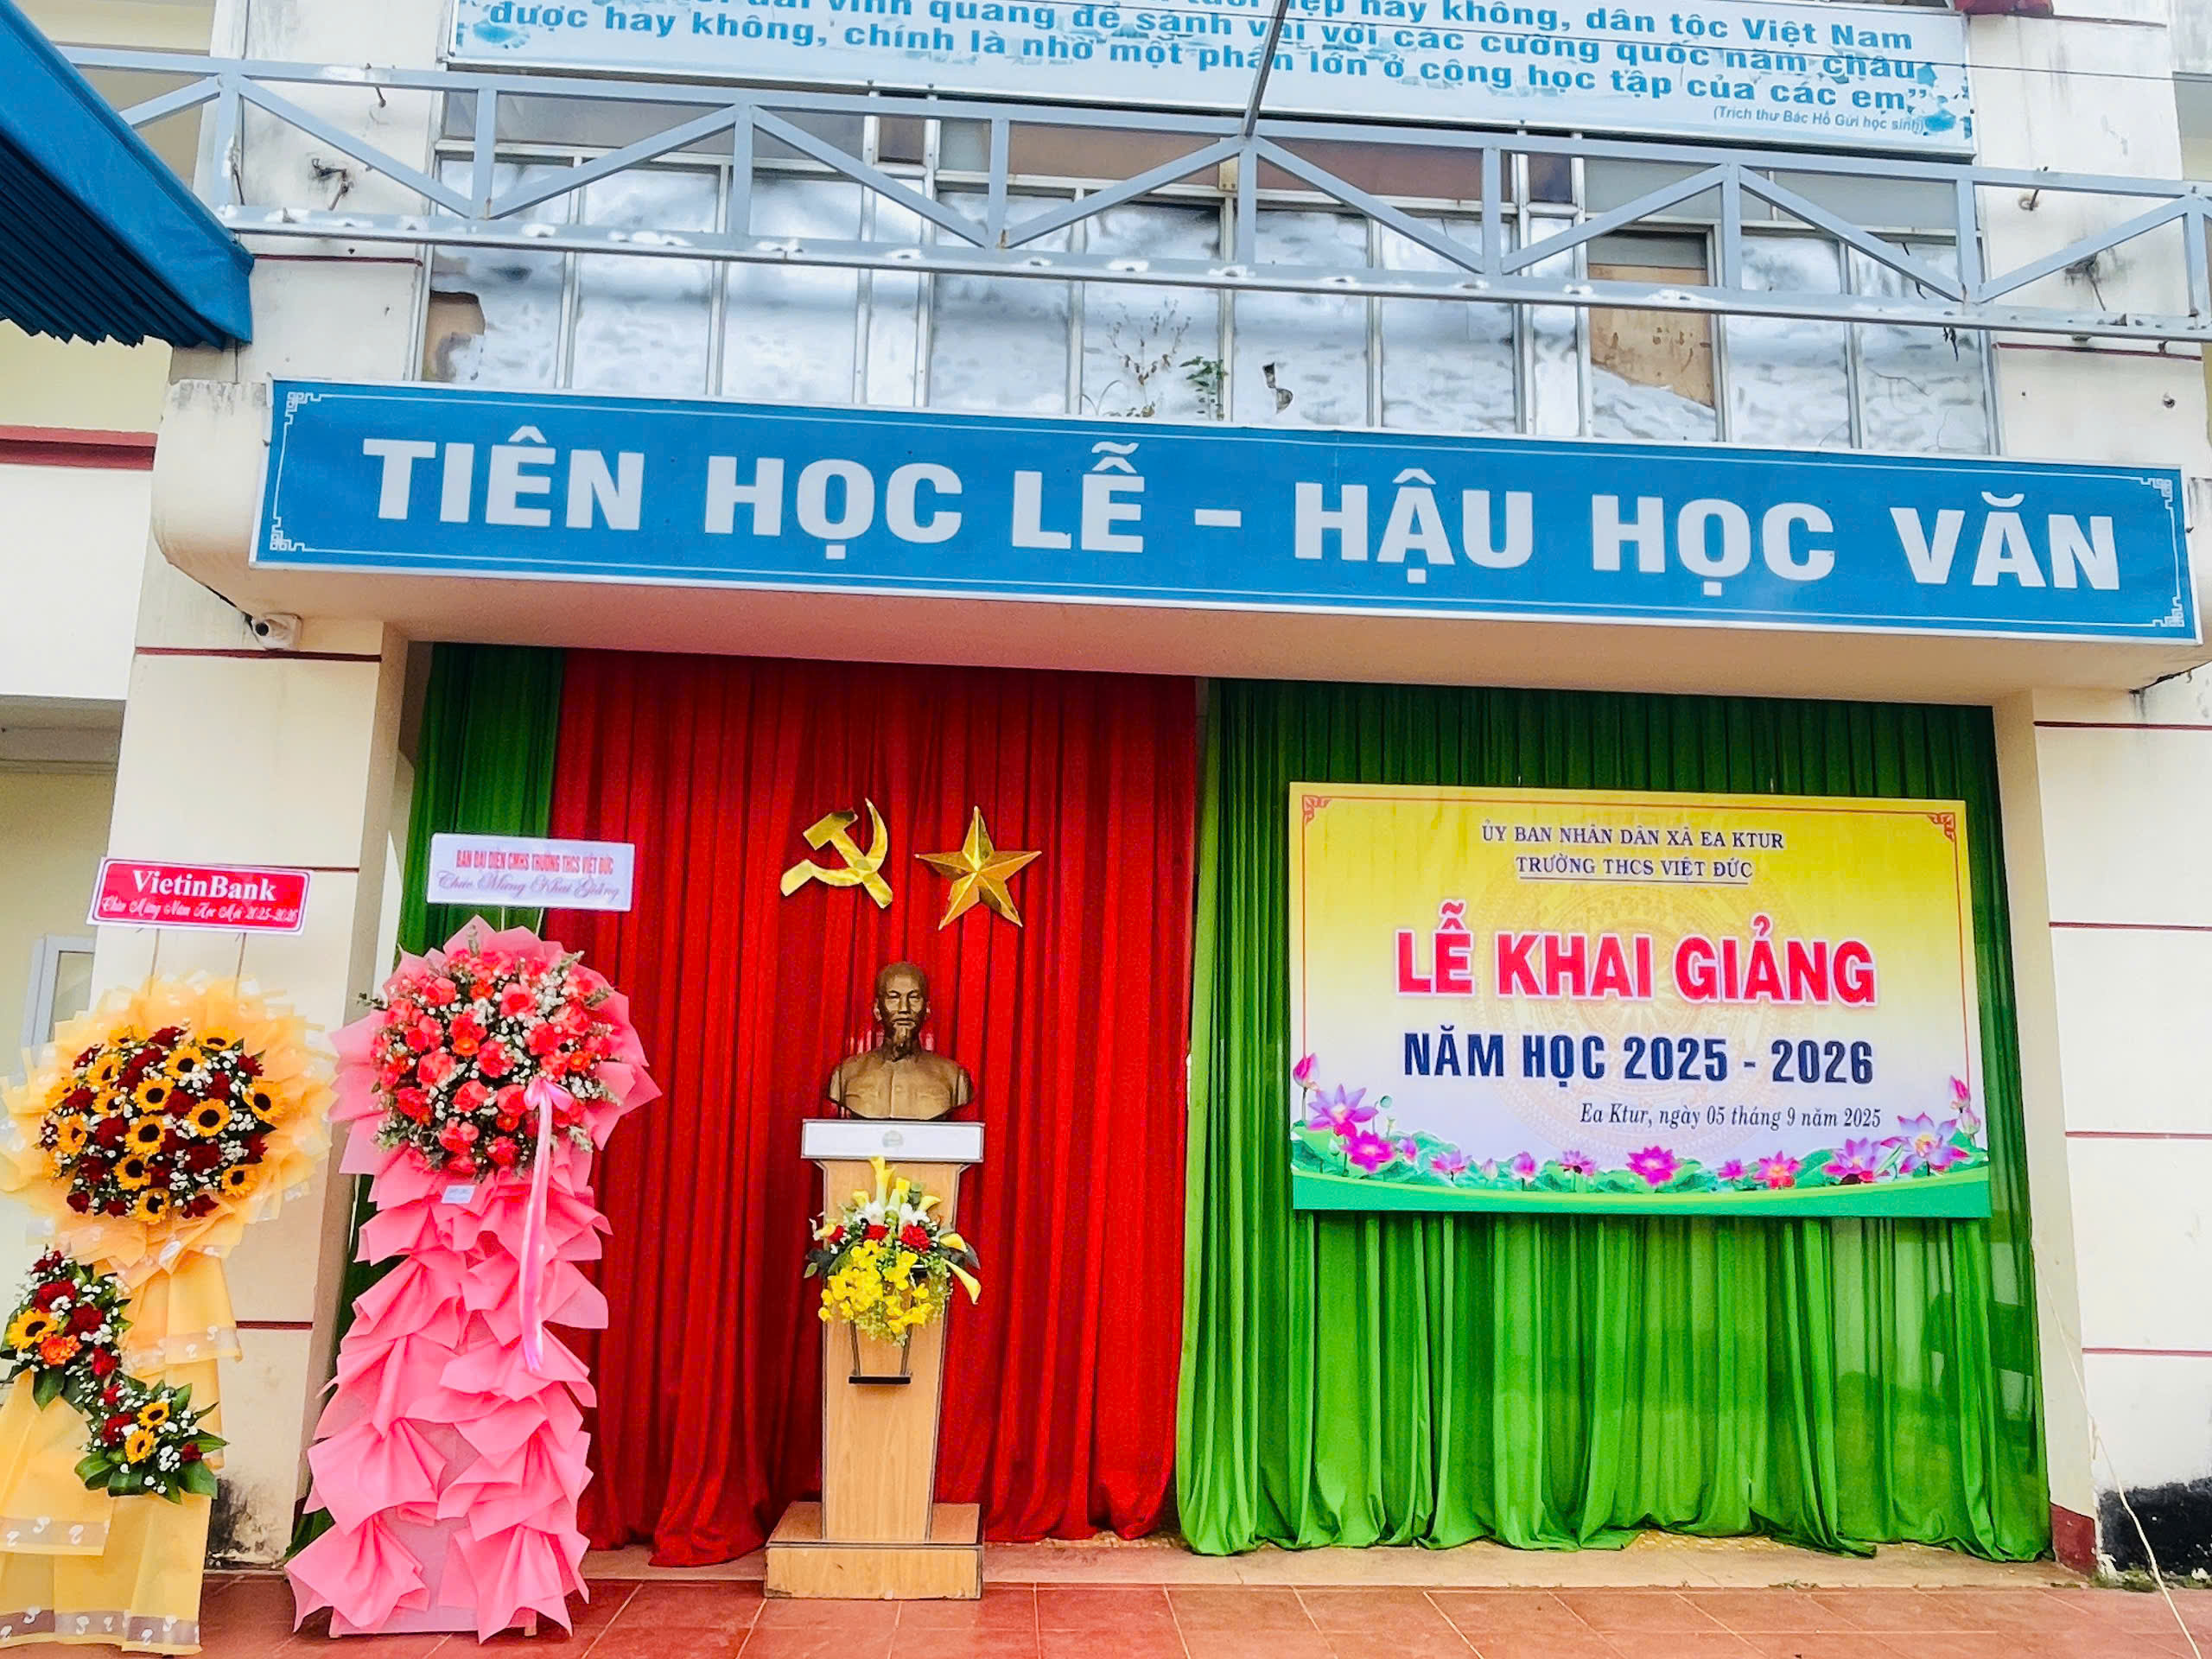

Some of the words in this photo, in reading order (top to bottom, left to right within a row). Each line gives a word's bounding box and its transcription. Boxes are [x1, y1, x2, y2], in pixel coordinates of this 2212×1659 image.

[929, 0, 1055, 29] quang
[1072, 1, 1121, 29] để
[1822, 54, 1916, 79] châu
[1361, 0, 1427, 23] hay
[1442, 0, 1570, 31] không,
[1586, 7, 1655, 33] dân
[1669, 13, 1728, 40] tộc
[1742, 17, 1817, 48] Việt
[1831, 24, 1913, 49] Nam
[489, 2, 588, 32] được
[605, 6, 676, 38] hay
[691, 12, 827, 47] không,
[844, 23, 955, 50] chính
[970, 30, 1005, 54] là
[1023, 35, 1094, 60] nhờ
[1109, 40, 1183, 68] một
[1310, 51, 1368, 76] lớn
[1384, 54, 1405, 79] ở
[1420, 59, 1512, 88] công
[1529, 64, 1596, 93] học
[1611, 69, 1673, 99] tập
[1687, 74, 1755, 100] của
[1771, 81, 1837, 105] các
[1756, 108, 1780, 122] thư
[1863, 115, 1887, 131] học
[362, 425, 645, 531] TIÊN
[703, 454, 963, 561] HỌC
[1012, 442, 1146, 554] LỄ
[1294, 467, 1535, 585] HẬU
[1591, 493, 1836, 597] HỌC
[1889, 490, 2120, 591] VĂN
[1514, 825, 1552, 843] BAN
[1560, 824, 1613, 845] NHÂN
[1620, 826, 1659, 845] DÂN
[1667, 827, 1694, 847] XÃ
[1700, 830, 1726, 847] EA
[1732, 832, 1784, 849] KTUR
[132, 868, 277, 902] VietinBank
[1516, 853, 1595, 874] TRƯỜNG
[1603, 859, 1654, 876] THCS
[1661, 857, 1706, 880] VIỆT
[1713, 858, 1754, 879] ĐỨC
[1396, 899, 1473, 995] LỄ
[1496, 933, 1652, 999] KHAI
[1674, 913, 1877, 1005] GIẢNG
[1403, 1025, 1505, 1077] NĂM
[1522, 1034, 1605, 1088] HỌC
[1623, 1036, 1728, 1082] 2025
[1770, 1039, 1874, 1084] 2026
[1580, 1103, 1603, 1123] Ea
[1609, 1103, 1653, 1127] Ktur,
[1659, 1105, 1700, 1130] ngày
[1707, 1106, 1726, 1125] 05
[1731, 1105, 1782, 1131] tháng
[1787, 1107, 1796, 1127] 9
[1801, 1107, 1838, 1128] năm
[1843, 1108, 1882, 1128] 2025
